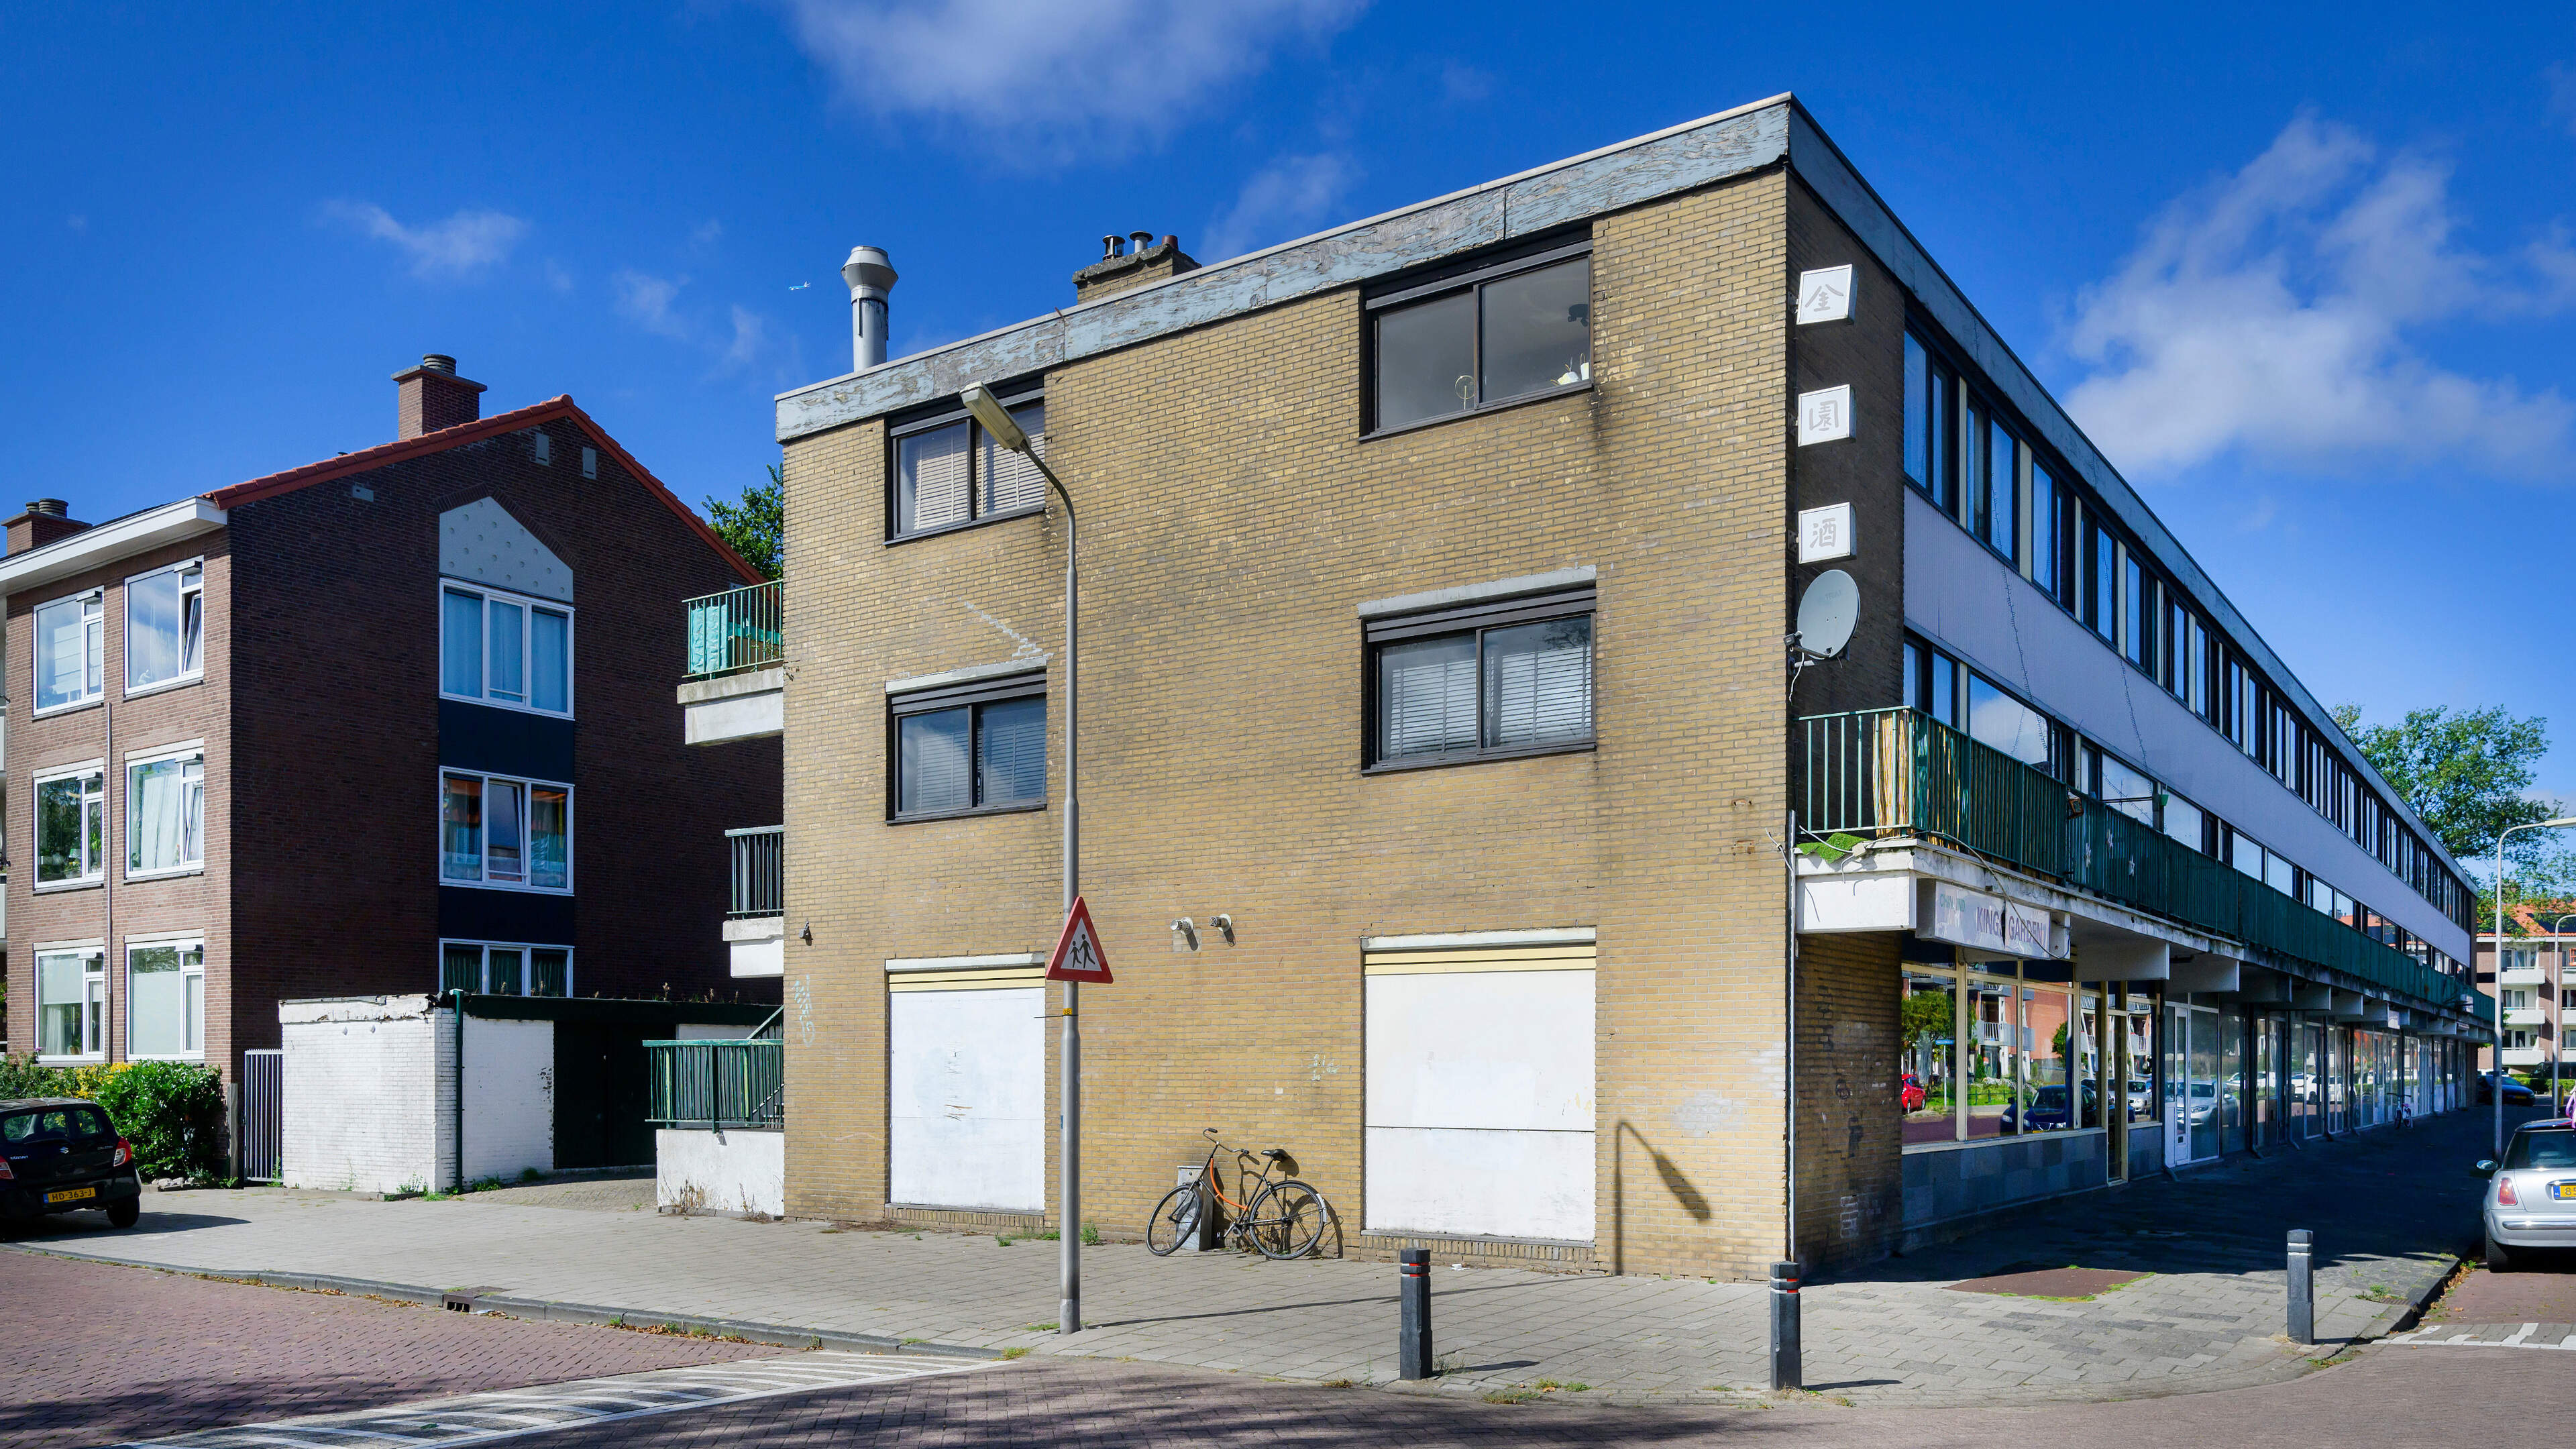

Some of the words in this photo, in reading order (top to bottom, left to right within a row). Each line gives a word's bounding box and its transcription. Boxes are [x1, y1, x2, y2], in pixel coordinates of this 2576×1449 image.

[1805, 284, 1844, 312] 金
[1809, 400, 1839, 431] 園
[1809, 517, 1836, 549] 酒
[1976, 906, 2003, 937] KING
[2008, 915, 2043, 945] GARDEN
[52, 1189, 92, 1201] HD-363-J
